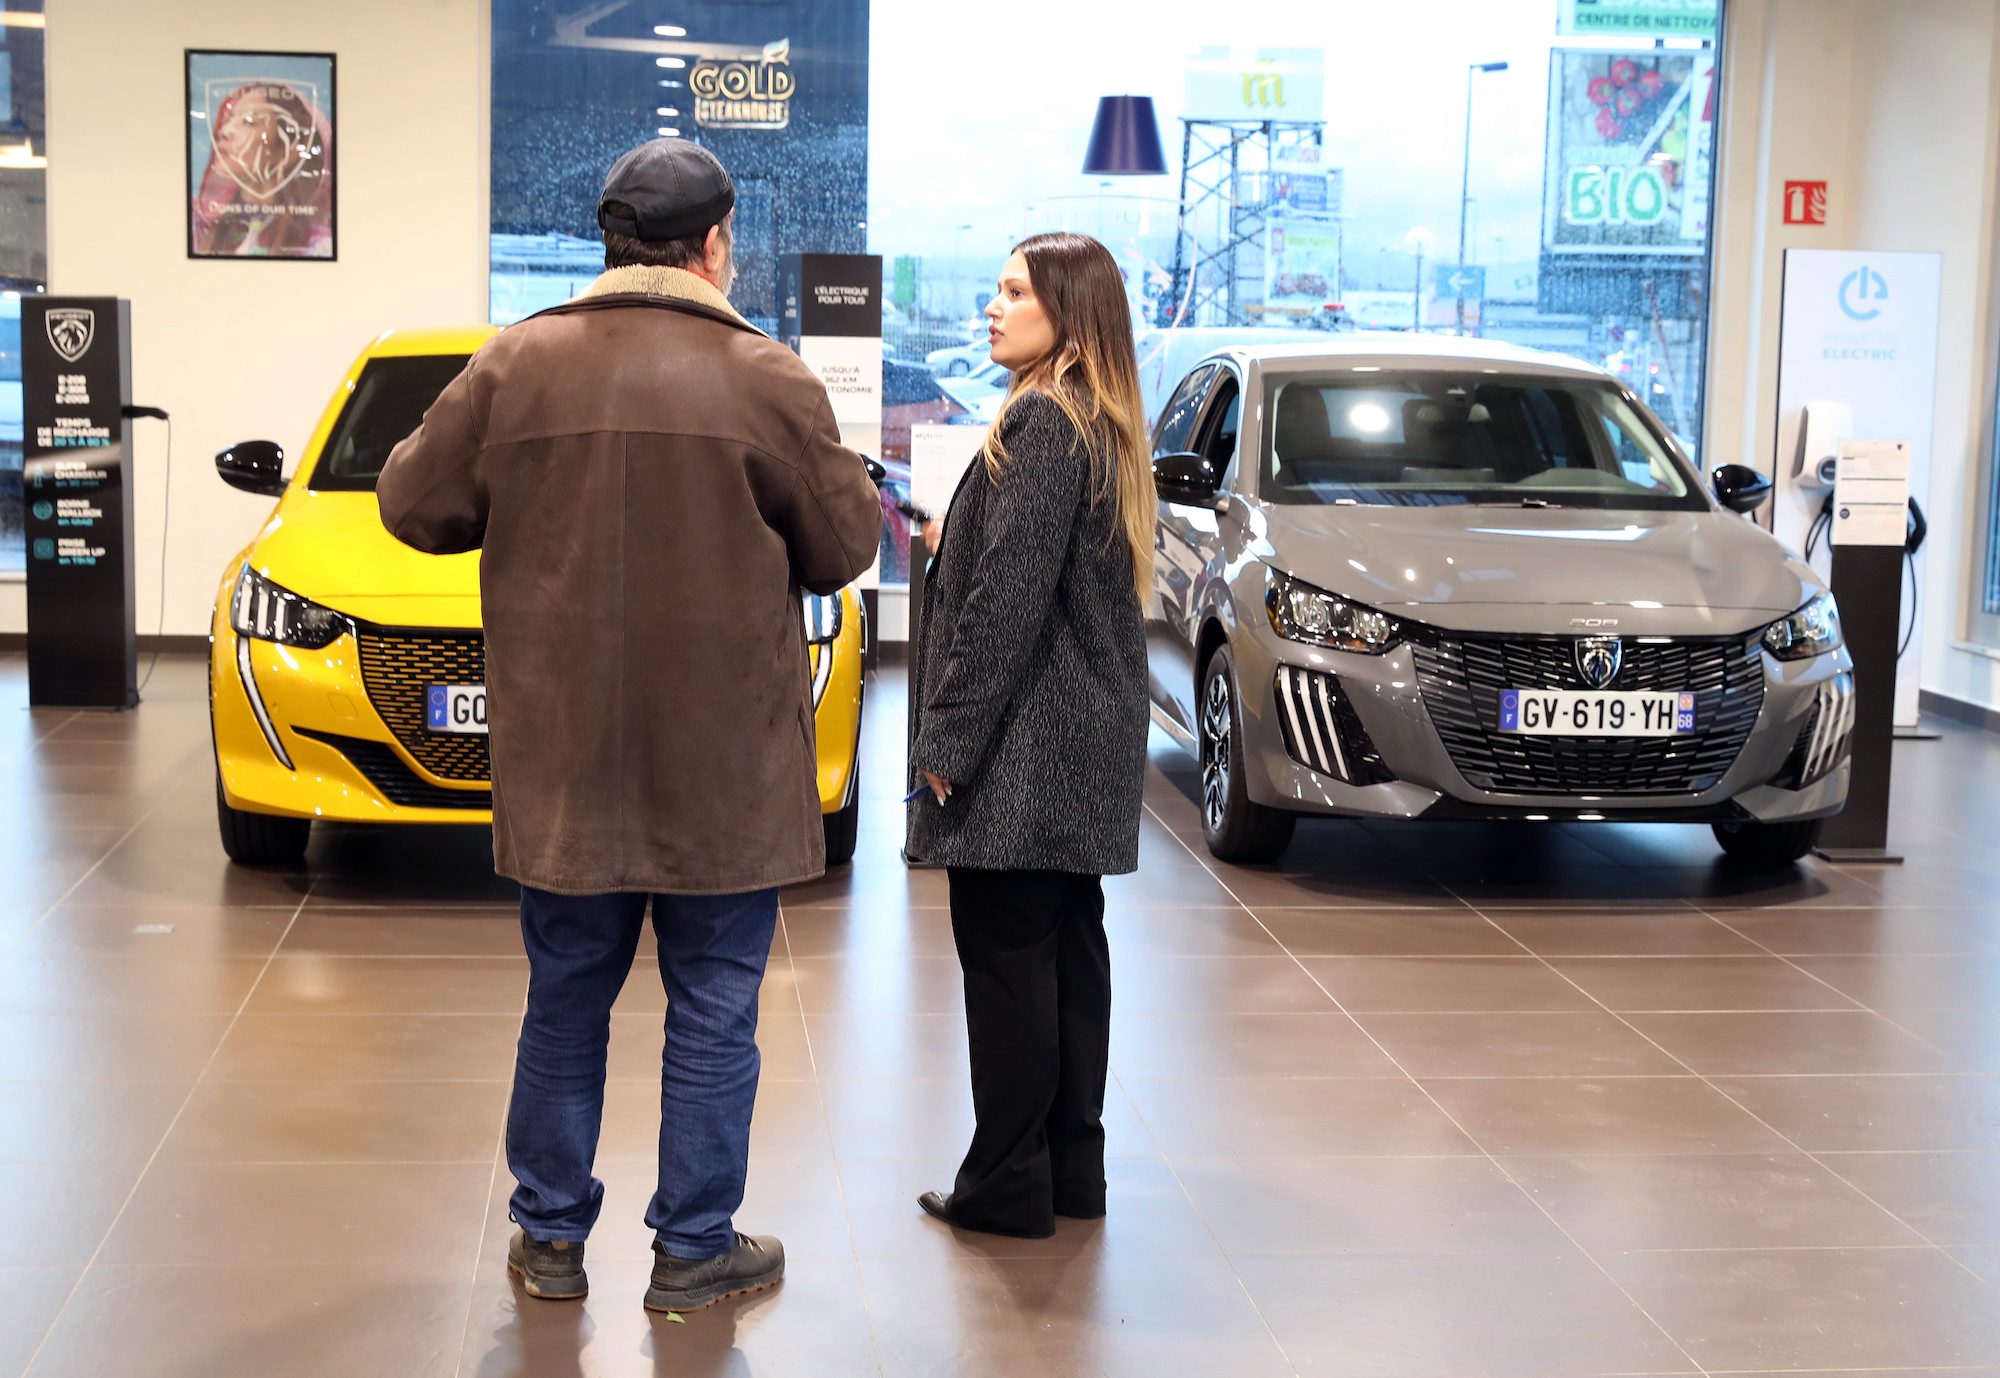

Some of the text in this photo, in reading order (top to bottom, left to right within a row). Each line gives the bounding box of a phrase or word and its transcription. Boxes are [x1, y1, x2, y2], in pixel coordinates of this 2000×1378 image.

[689, 62, 796, 100] GOLD
[1569, 169, 1663, 221] BIO
[818, 296, 866, 306] POUR TOUS
[1823, 348, 1898, 361] ELECTRIC
[843, 377, 857, 385] KM
[435, 709, 442, 720] F
[1506, 698, 1694, 730] F GV-619-YH 68
